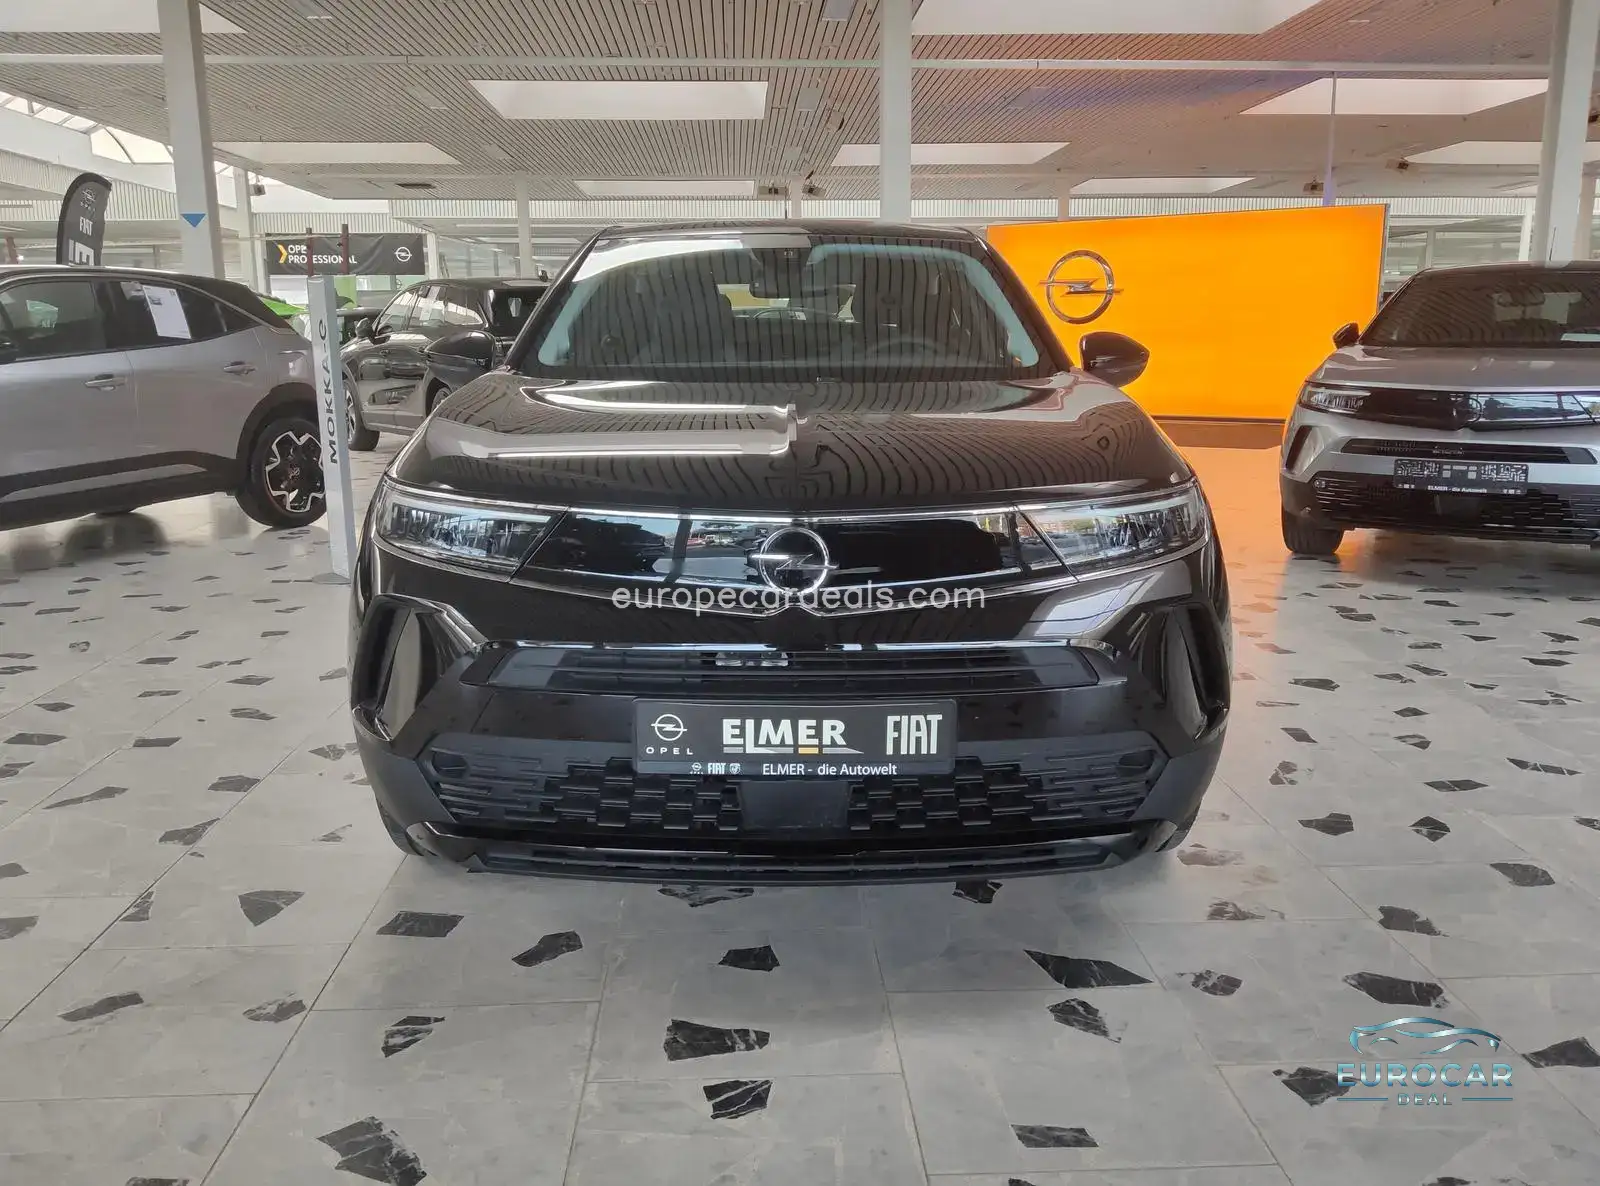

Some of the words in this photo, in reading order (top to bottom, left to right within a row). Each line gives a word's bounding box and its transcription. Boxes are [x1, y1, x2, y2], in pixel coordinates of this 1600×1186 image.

[288, 244, 307, 254] OPE
[288, 254, 358, 264] PROESSIONL
[318, 319, 338, 465] MOKKA-C
[722, 718, 847, 754] ELMER
[886, 714, 943, 755] FIAT
[645, 747, 694, 755] OPEL
[707, 762, 726, 775] FIAT
[762, 763, 805, 775] ELMER
[817, 763, 837, 775] die
[840, 763, 898, 775] Autowelt
